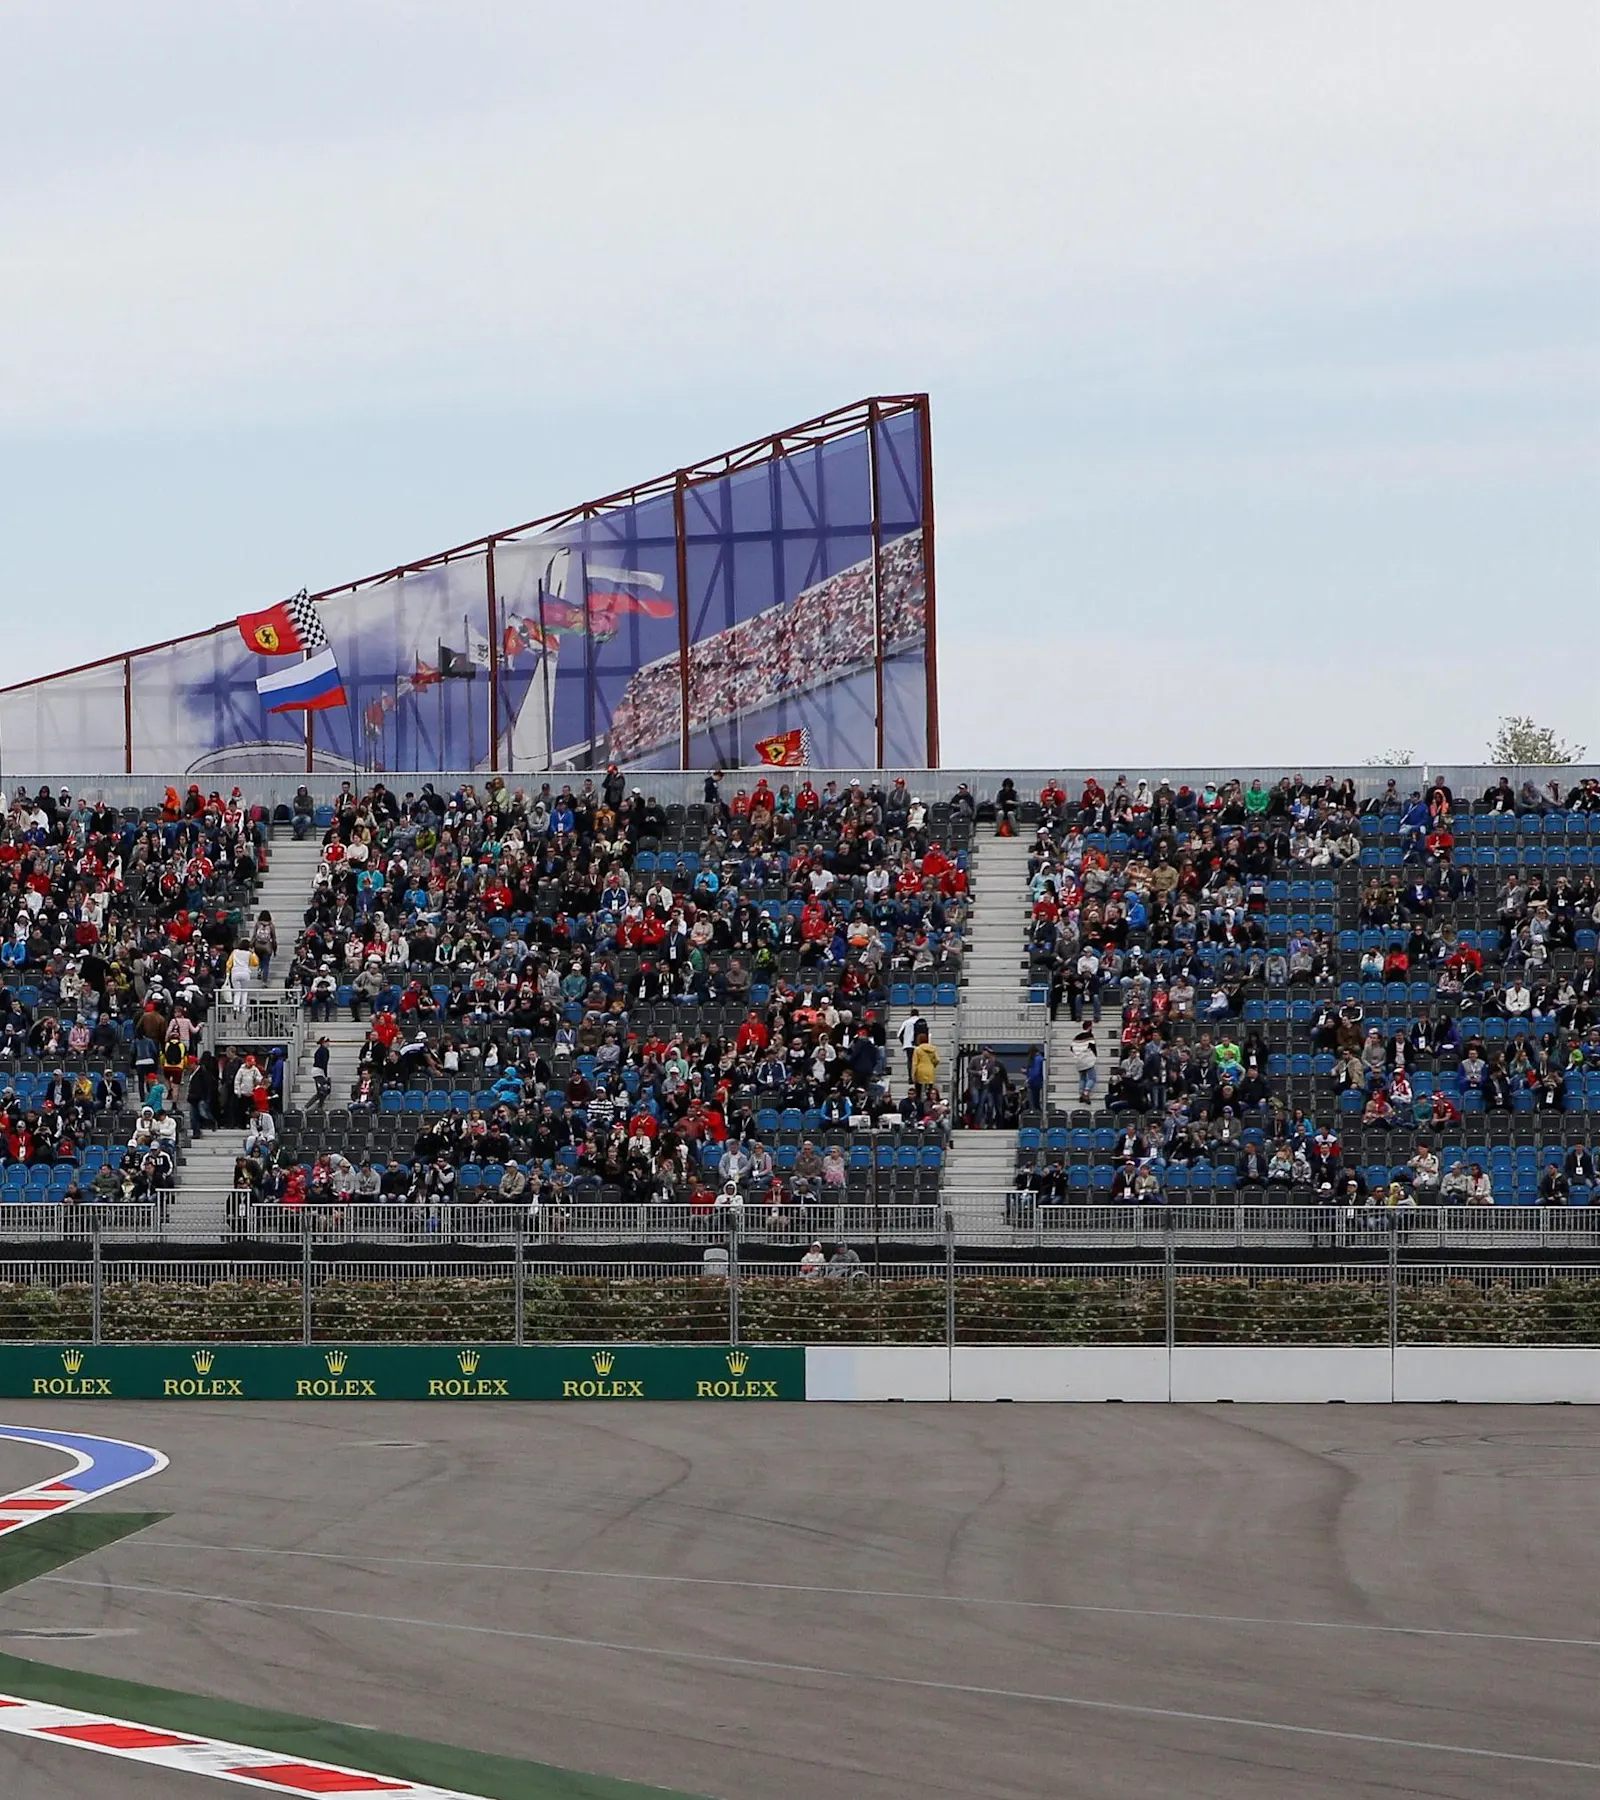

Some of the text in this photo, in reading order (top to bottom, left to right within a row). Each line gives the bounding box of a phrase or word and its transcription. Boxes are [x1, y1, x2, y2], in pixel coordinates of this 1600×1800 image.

[34, 1379, 111, 1394] ROLEX
[164, 1380, 242, 1395] ROLEX
[297, 1380, 376, 1395] ROLEX
[429, 1380, 508, 1395] ROLEX
[564, 1380, 643, 1396] ROLEX
[697, 1380, 777, 1396] ROLEX
